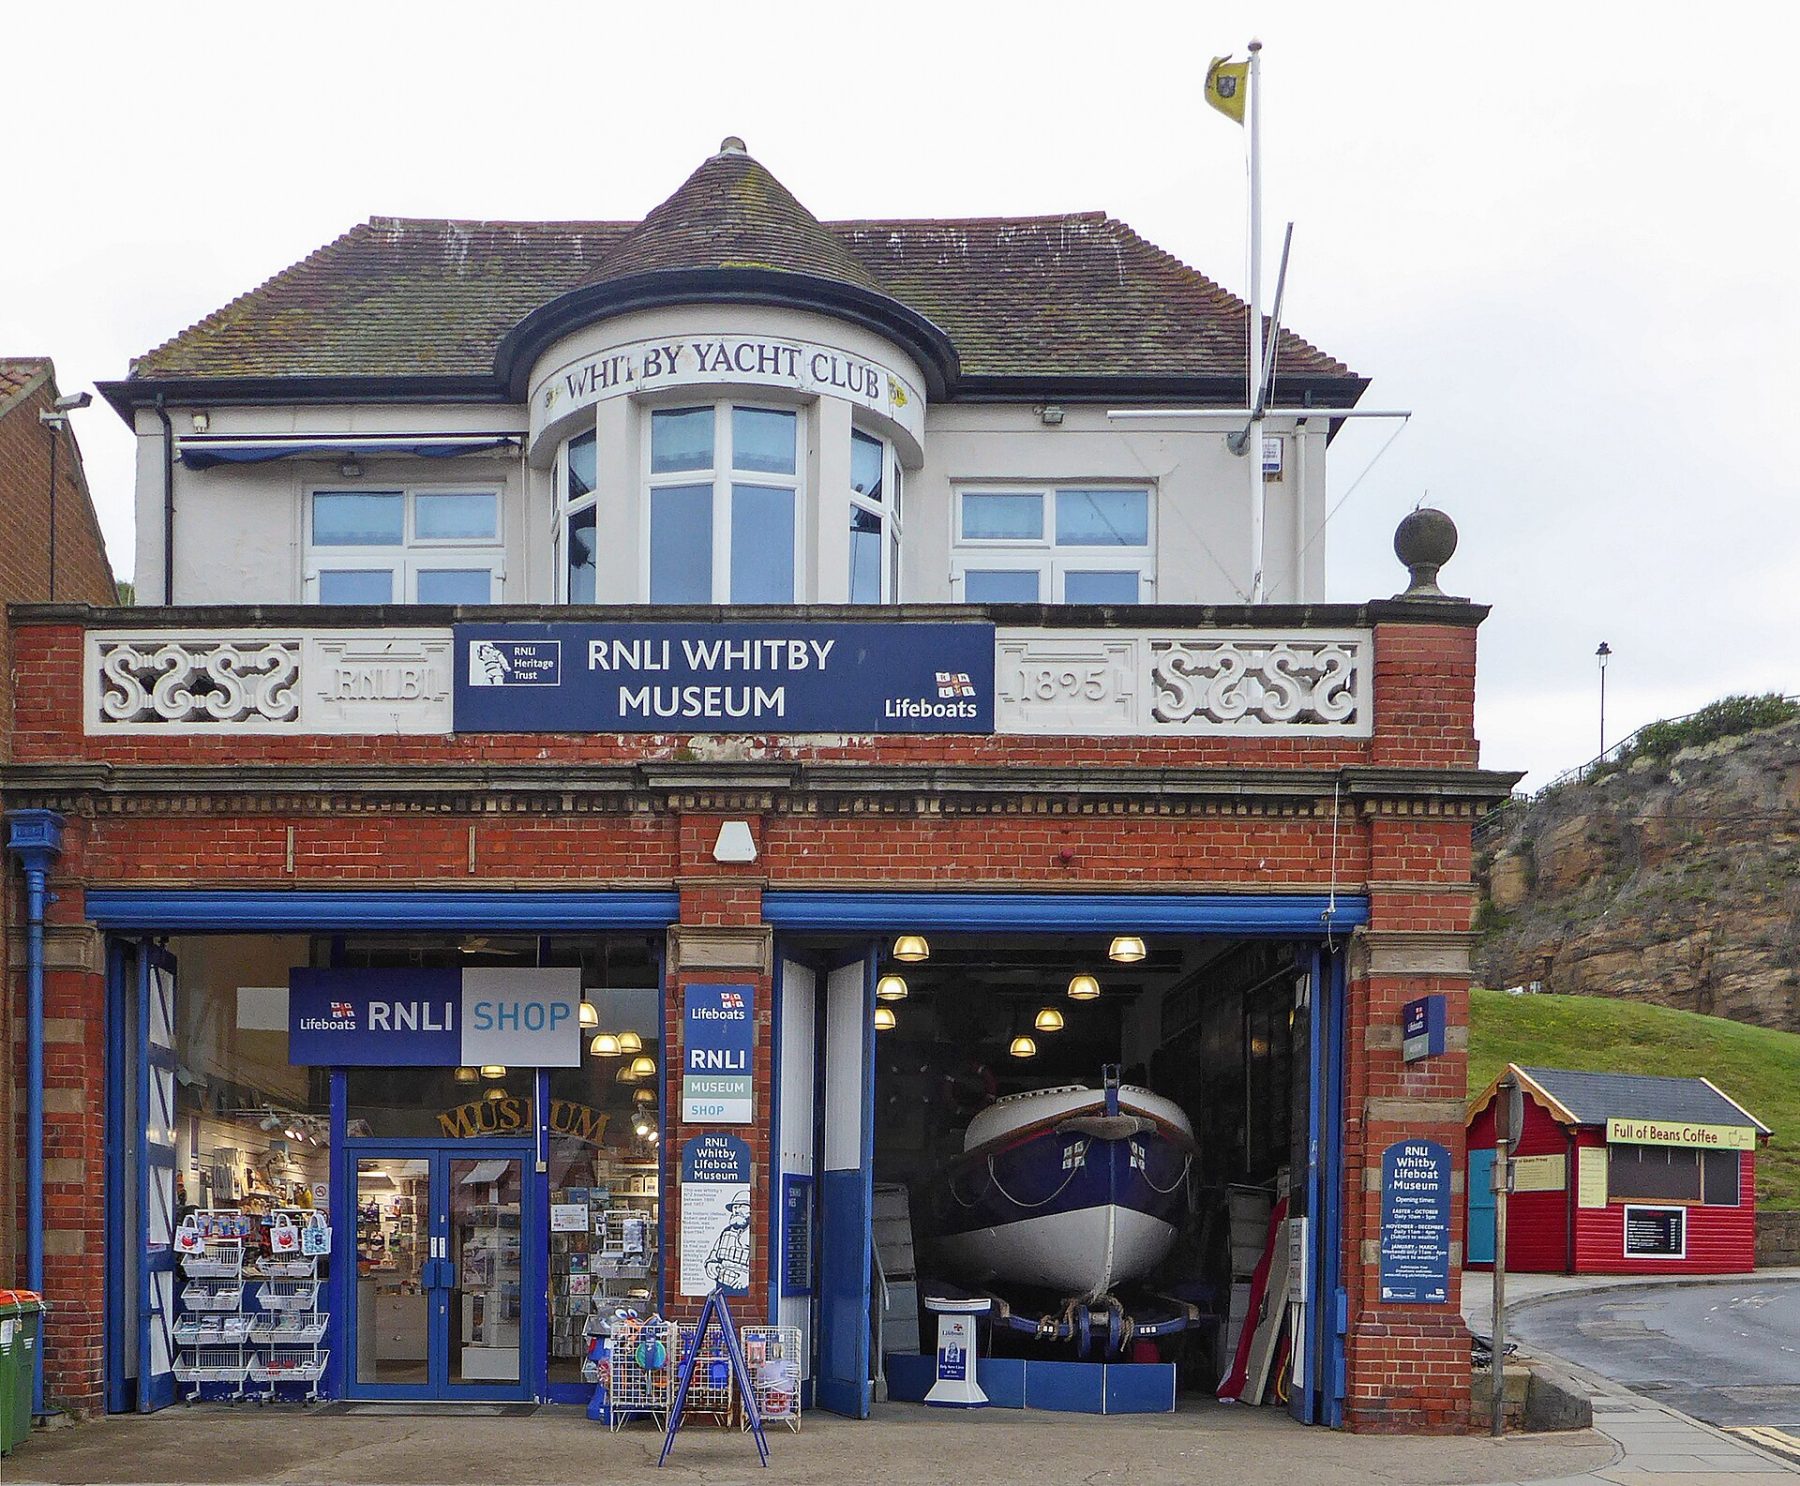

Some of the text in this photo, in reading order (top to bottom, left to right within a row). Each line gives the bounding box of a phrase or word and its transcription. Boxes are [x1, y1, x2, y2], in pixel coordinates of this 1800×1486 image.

[692, 342, 801, 377] YACHT
[810, 354, 879, 399] CLUB
[514, 647, 536, 656] RNLI
[588, 640, 835, 670] RNLI WHITBY
[514, 659, 554, 669] Heritage
[514, 671, 538, 680] Trust
[1019, 669, 1107, 701] 1895
[619, 686, 785, 717] MUSEUM
[885, 699, 977, 718] Lifeboats
[300, 1001, 571, 1032] Lifeboats RNLI SHOP
[692, 1008, 745, 1020] Lifeboats
[691, 1050, 745, 1069] RNLI
[692, 1082, 744, 1093] MUSEUM
[692, 1105, 724, 1116] SHOP
[1614, 1124, 1718, 1143] Full of Beans Coffee
[705, 1137, 728, 1147] RNLI
[697, 1148, 736, 1161] Whitby
[1405, 1146, 1428, 1156] RNLI
[694, 1159, 738, 1169] Lifeboat
[1396, 1158, 1436, 1169] Whitby
[694, 1171, 738, 1181] Museum
[1394, 1169, 1439, 1179] Lifeboat
[1393, 1180, 1438, 1190] Museum
[1395, 1196, 1419, 1204] Opening
